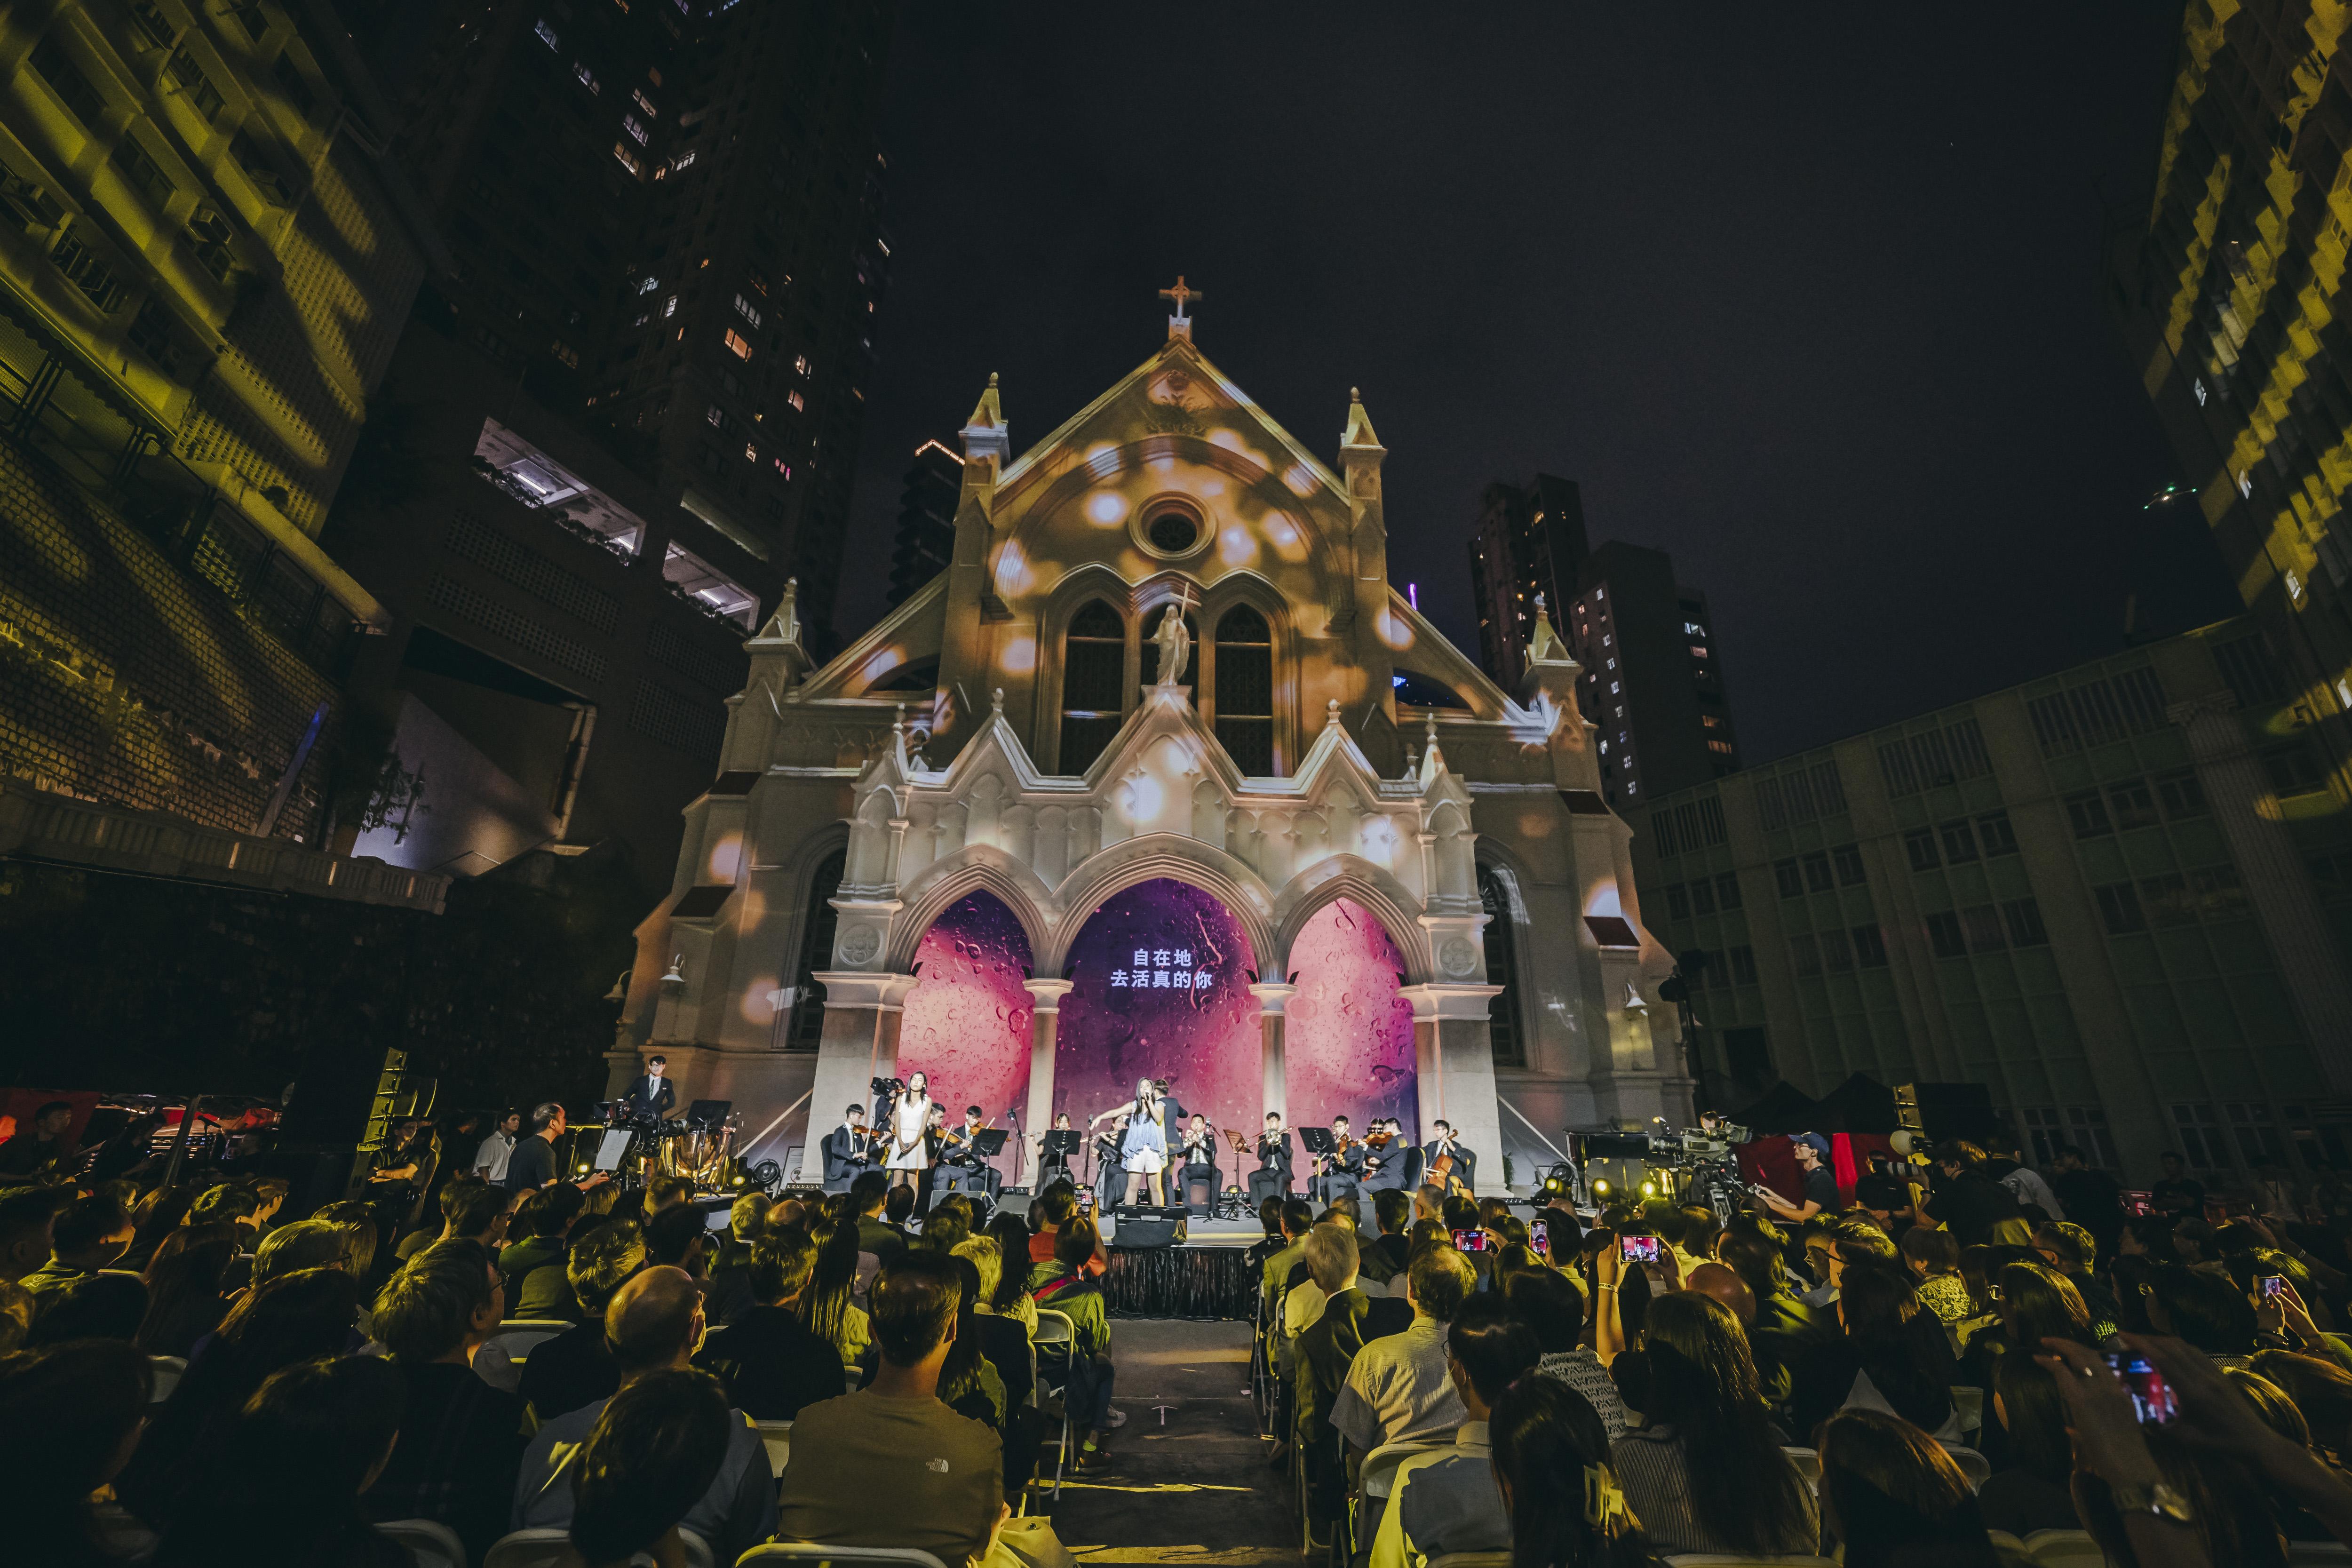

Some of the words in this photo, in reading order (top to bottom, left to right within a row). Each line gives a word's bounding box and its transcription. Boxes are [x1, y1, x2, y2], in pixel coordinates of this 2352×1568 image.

[1134, 948, 1192, 967] 自在地
[1110, 969, 1212, 989] 去活真的你
